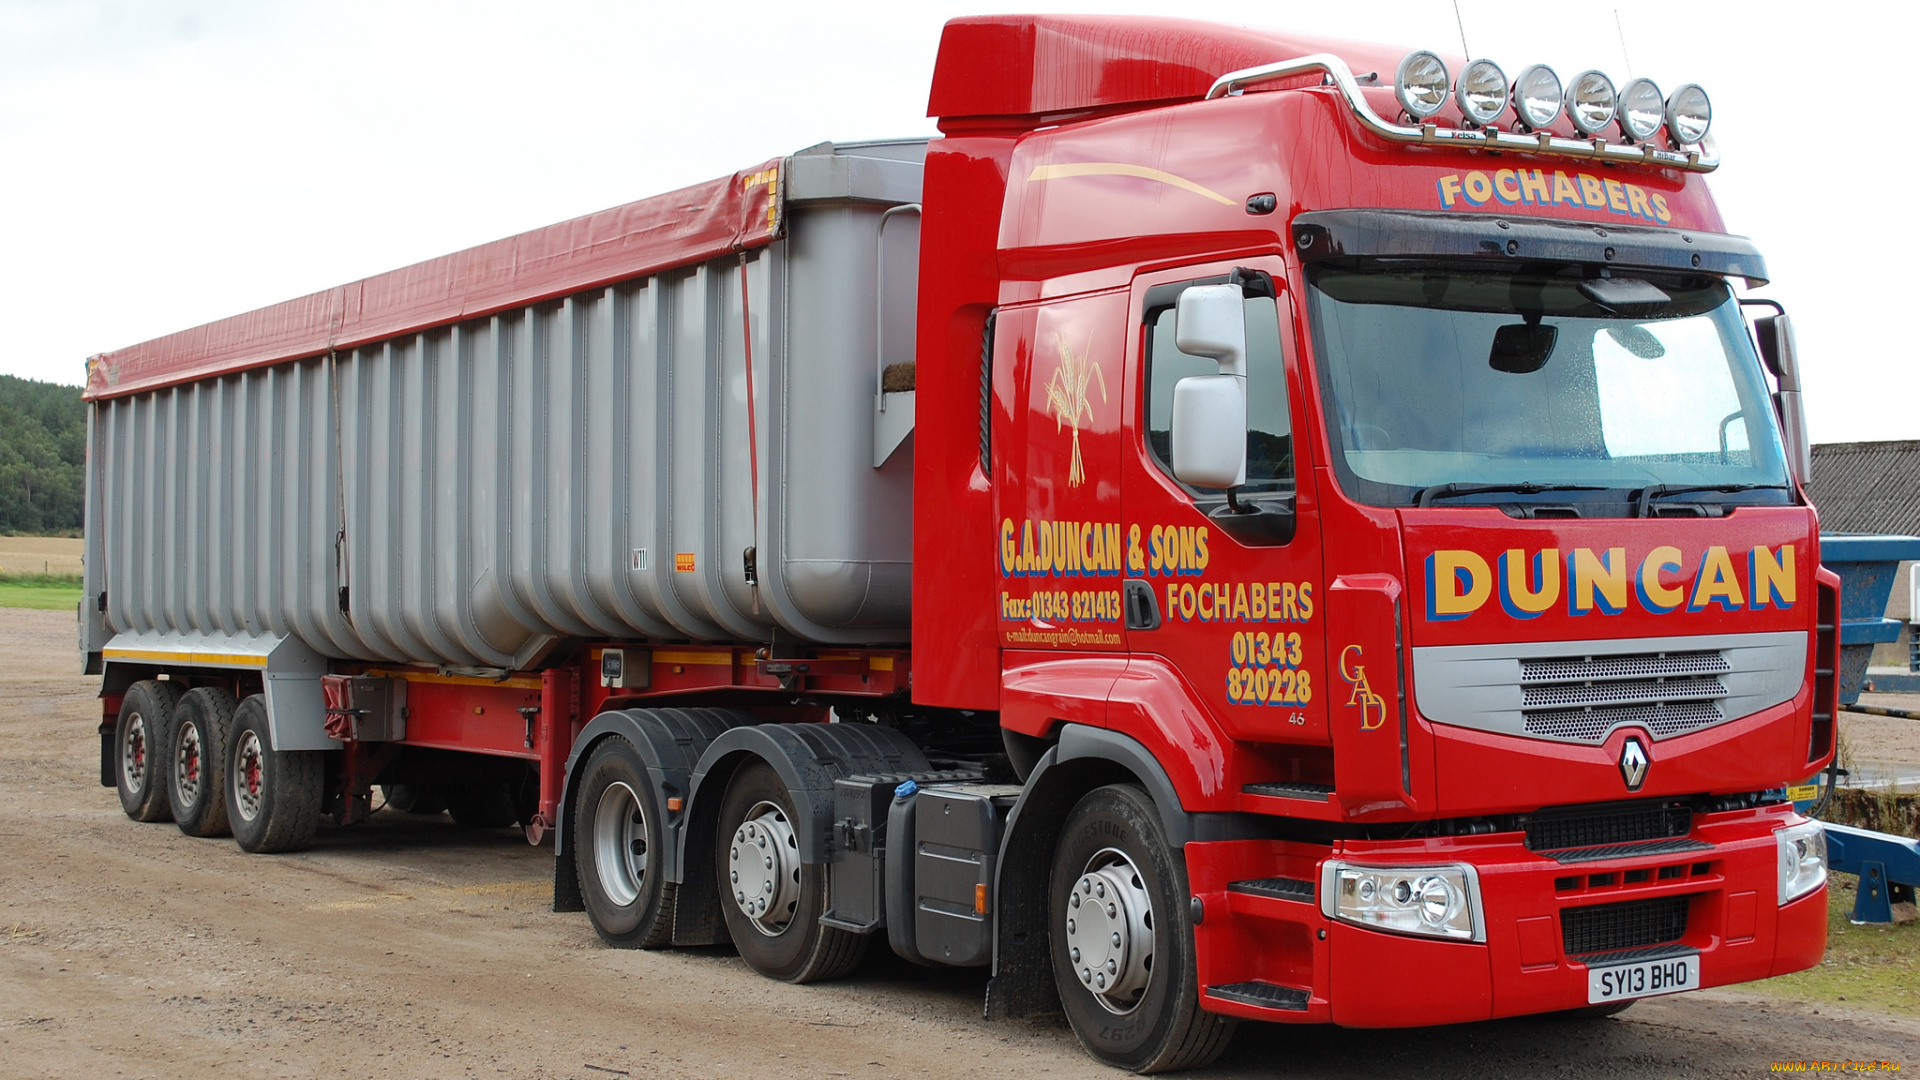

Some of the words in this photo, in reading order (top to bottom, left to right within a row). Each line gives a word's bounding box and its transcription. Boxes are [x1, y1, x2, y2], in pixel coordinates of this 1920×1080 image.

[1437, 168, 1671, 225] FOCHABERS
[1126, 523, 1145, 576] &
[1148, 524, 1209, 576] SONS
[1166, 582, 1314, 623] FOCHABERS
[1424, 544, 1797, 622] DUNCAN
[1071, 590, 1121, 623] 821413
[1231, 631, 1303, 669] 01343
[1226, 667, 1312, 707] 820228
[1288, 712, 1306, 726] 46
[1601, 967, 1645, 997] SY13
[1650, 961, 1687, 990] BHO
